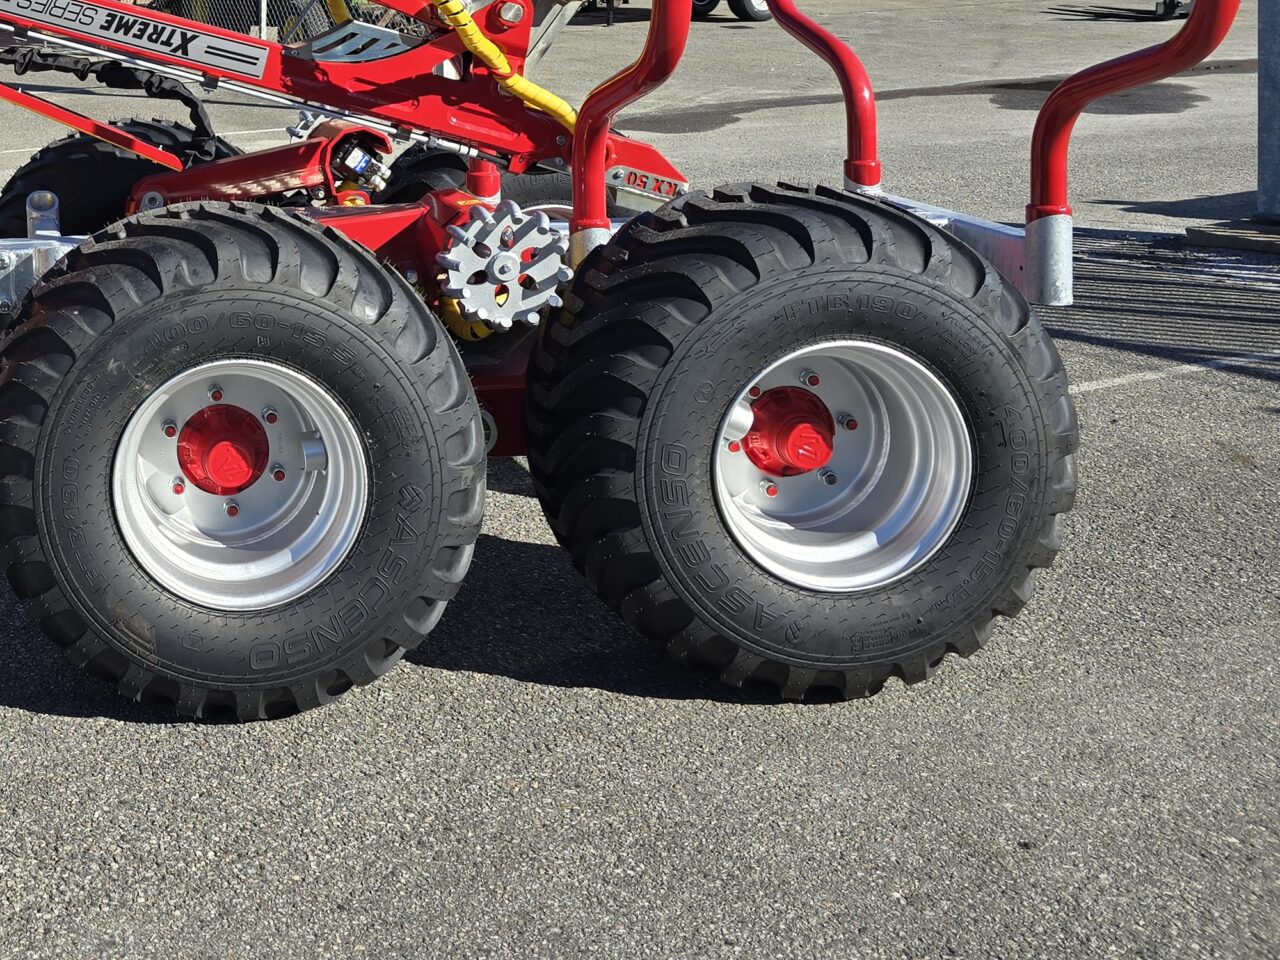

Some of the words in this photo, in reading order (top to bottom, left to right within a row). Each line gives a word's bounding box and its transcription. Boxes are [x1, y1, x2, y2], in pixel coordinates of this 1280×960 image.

[99, 12, 200, 57] XTREME
[625, 171, 649, 189] 50
[651, 177, 679, 197] KX
[660, 442, 780, 632] ASCENSO
[249, 512, 419, 671] ASCENSO
